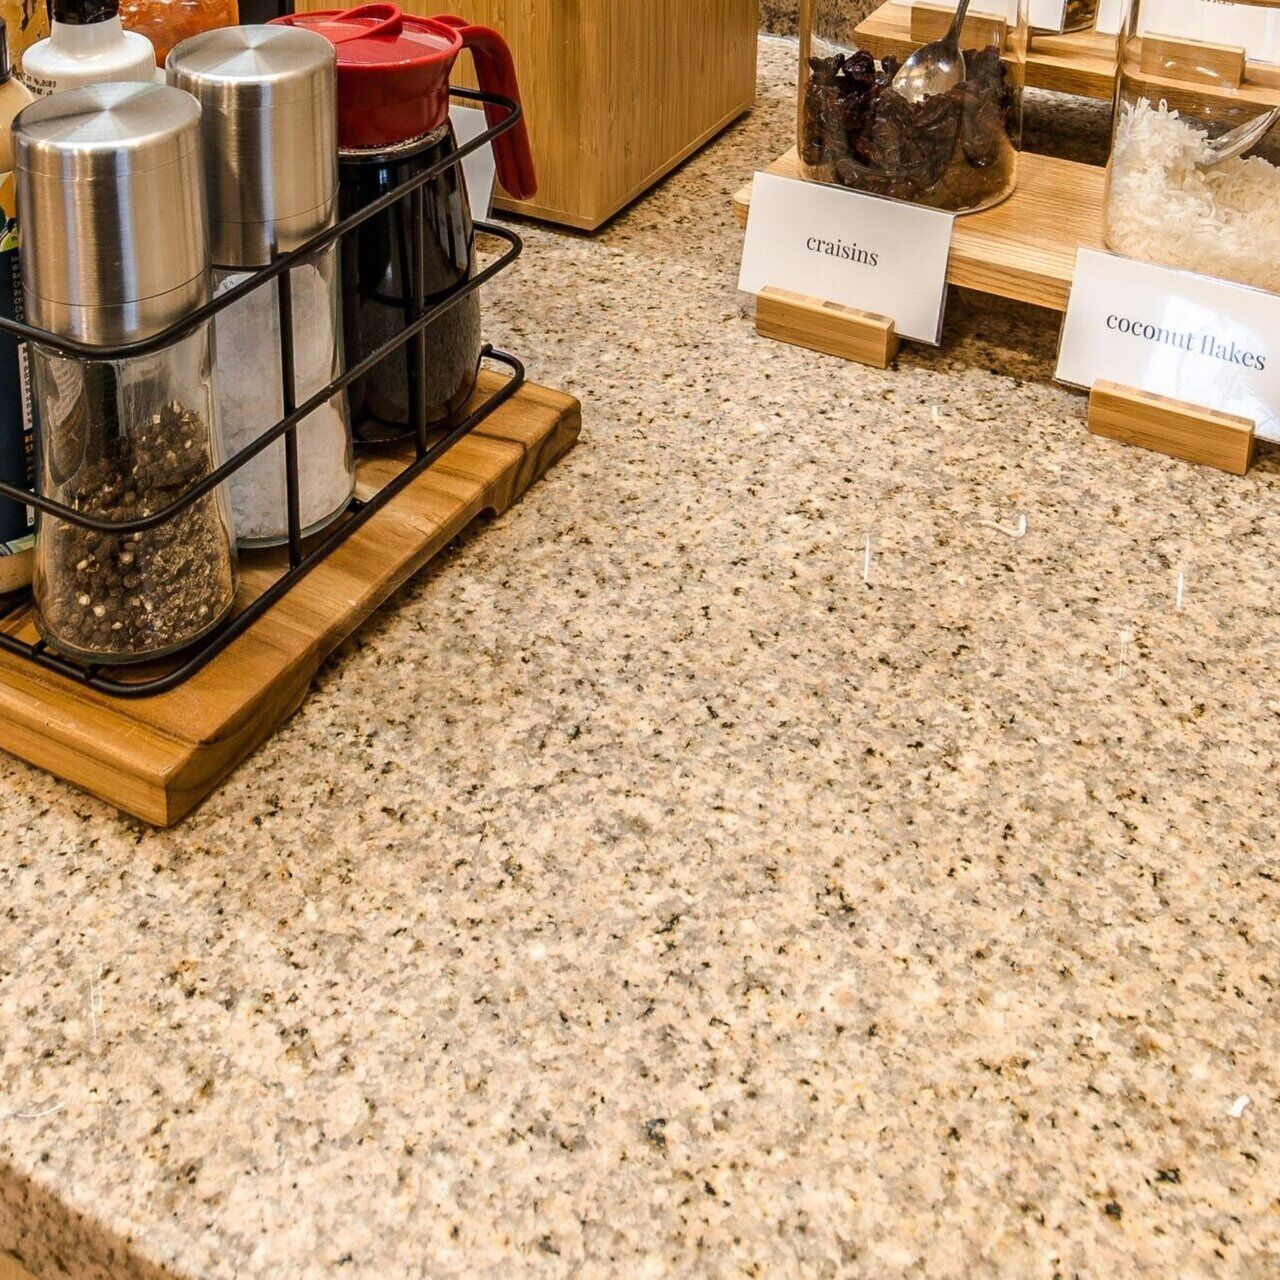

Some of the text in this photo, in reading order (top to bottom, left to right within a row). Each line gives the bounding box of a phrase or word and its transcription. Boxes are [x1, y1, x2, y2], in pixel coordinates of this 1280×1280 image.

[806, 237, 879, 266] craisins
[1106, 314, 1266, 371] coconut flakes
